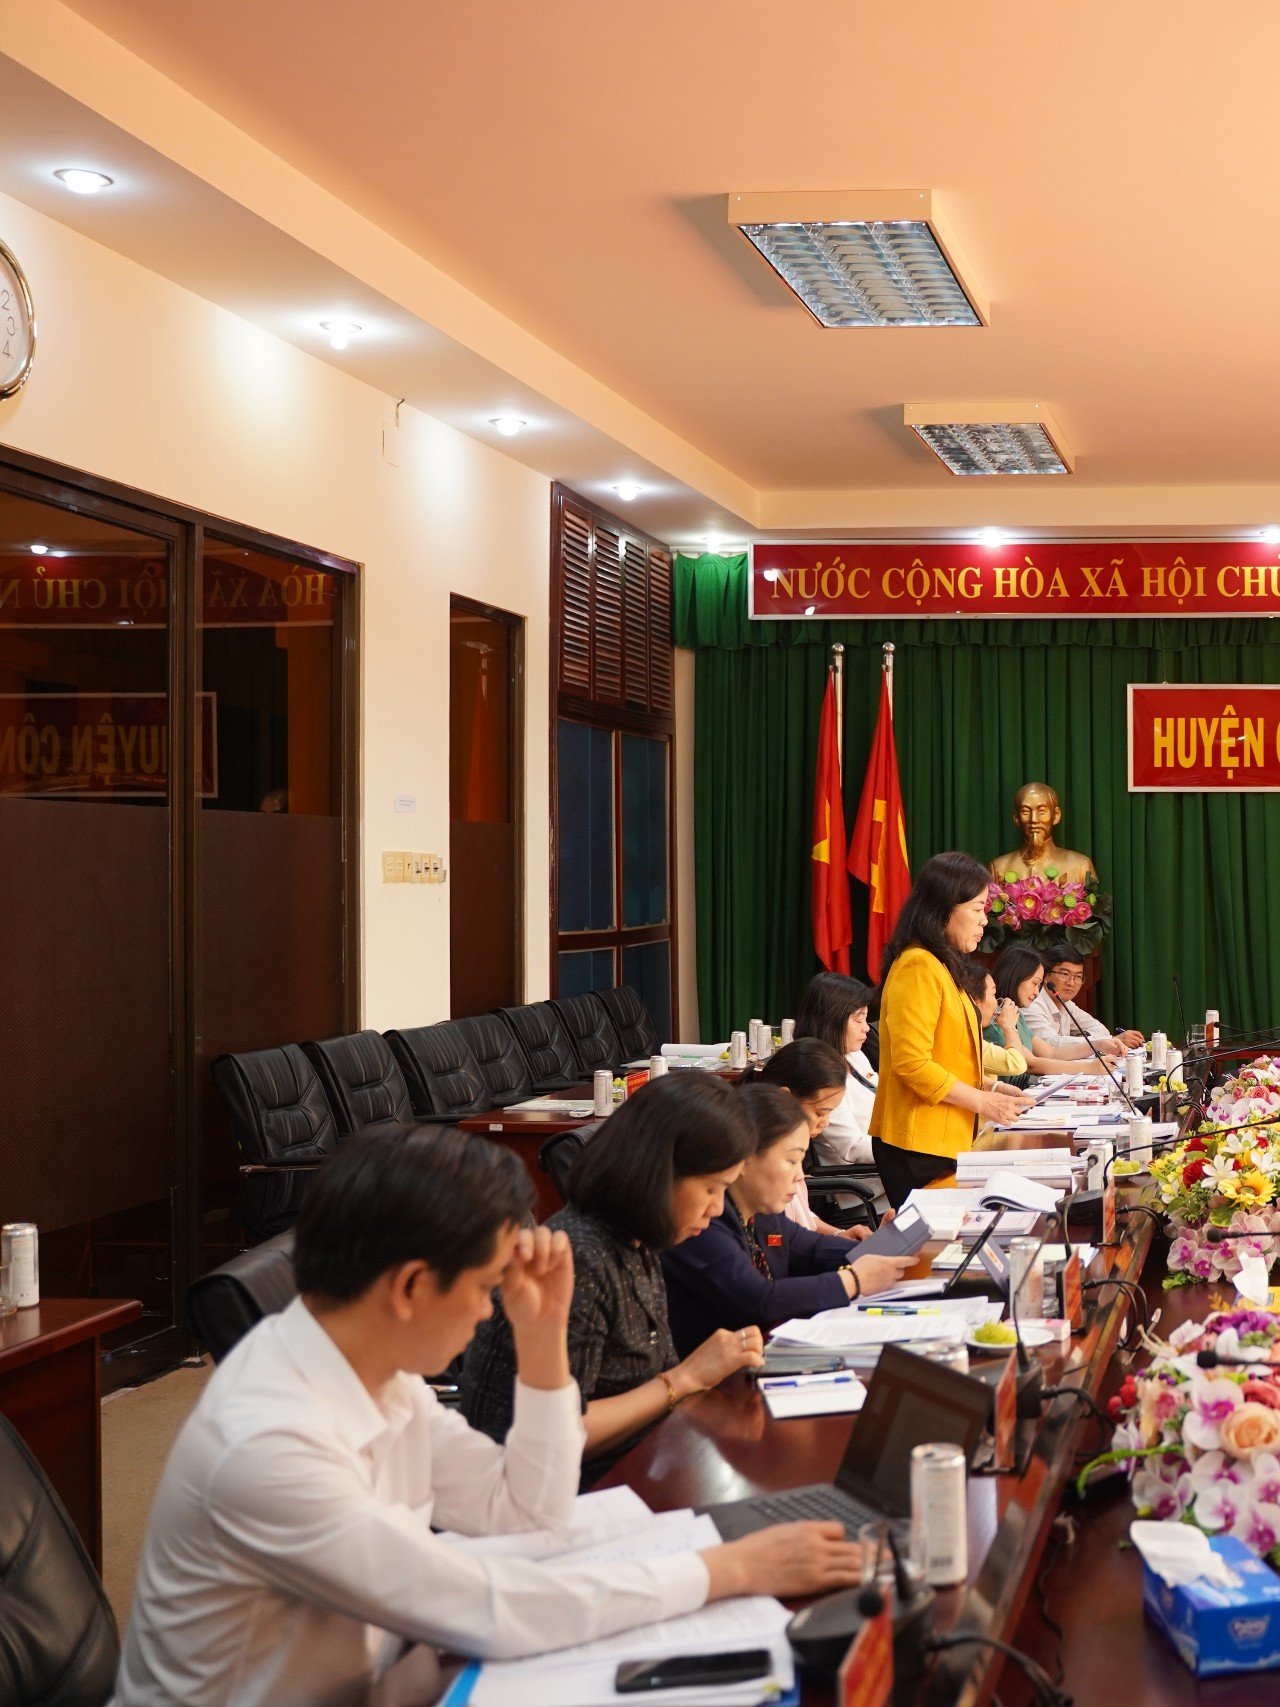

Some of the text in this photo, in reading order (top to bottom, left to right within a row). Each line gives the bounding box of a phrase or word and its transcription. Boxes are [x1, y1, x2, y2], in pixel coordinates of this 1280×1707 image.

[2, 290, 10, 311] 2
[7, 317, 16, 336] 3
[3, 341, 12, 357] 4
[771, 556, 871, 599] NƯỚC
[881, 558, 983, 606] CỘNG
[993, 556, 1070, 599] HÒA
[1081, 558, 1129, 597] XÃ
[1141, 557, 1207, 605] HỘI
[1154, 704, 1264, 779] HUYỆN
